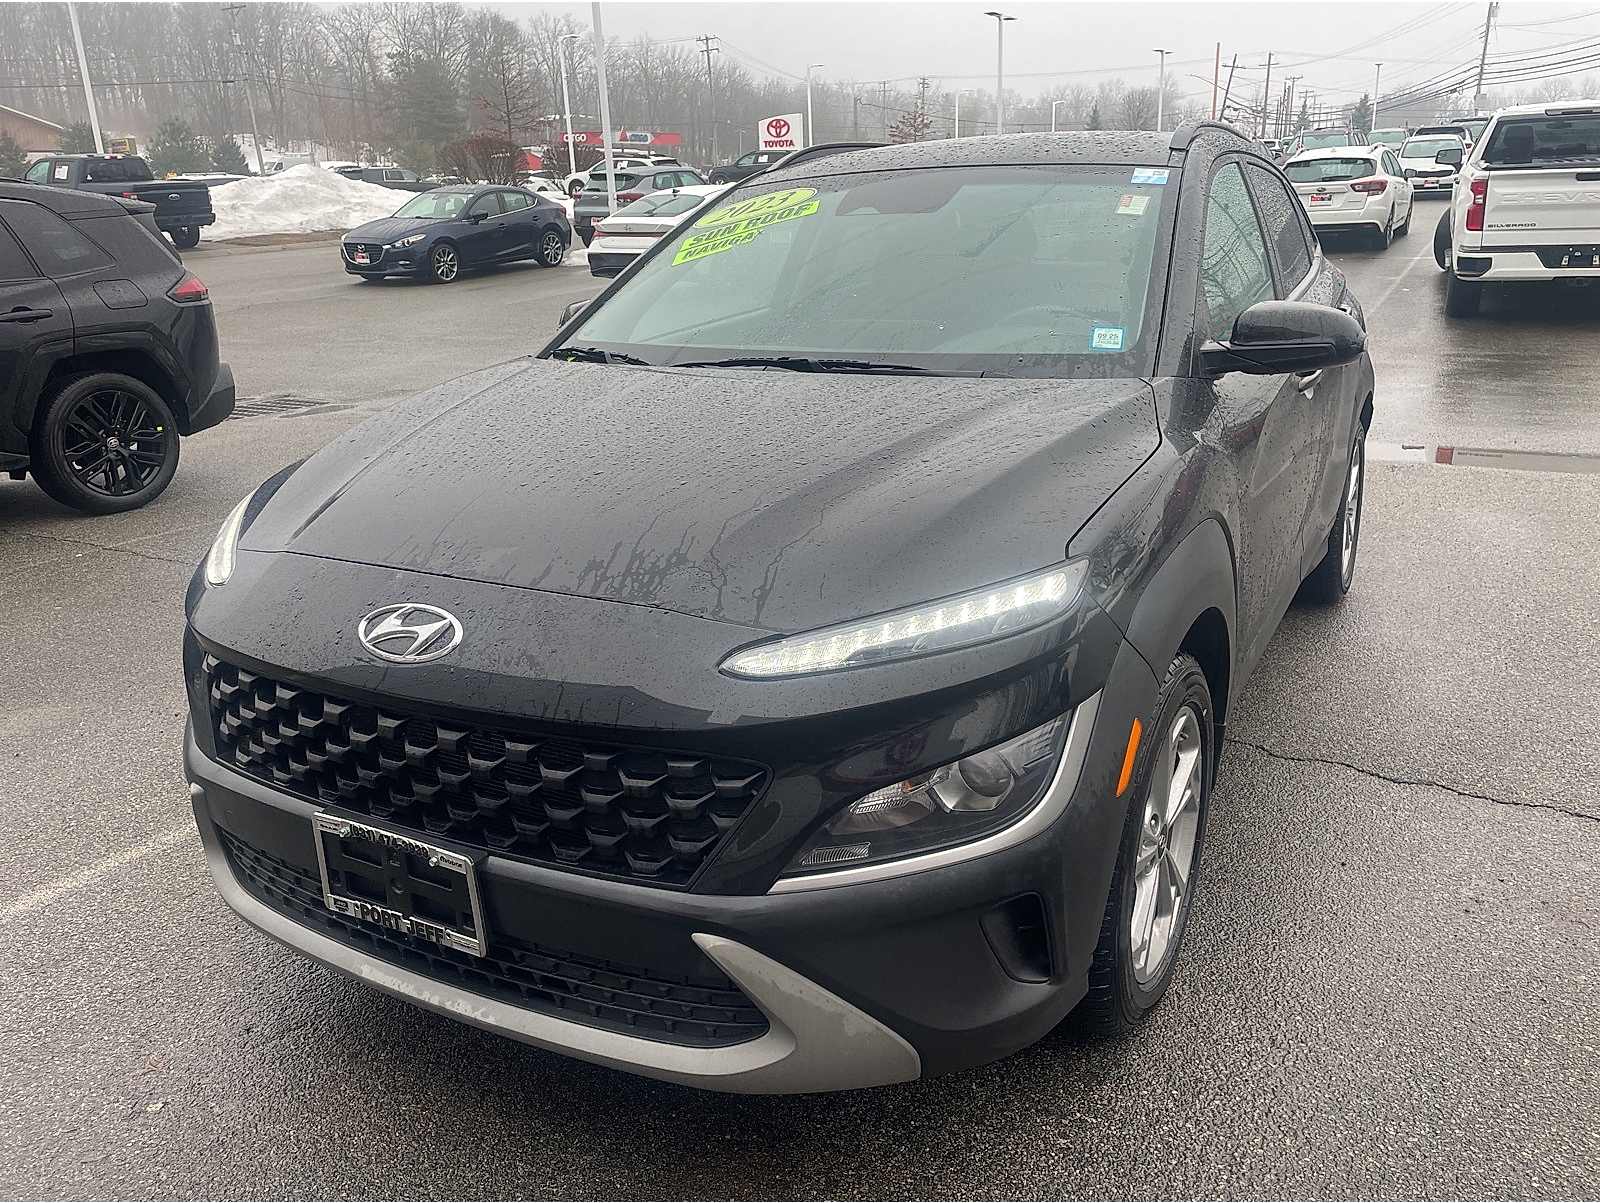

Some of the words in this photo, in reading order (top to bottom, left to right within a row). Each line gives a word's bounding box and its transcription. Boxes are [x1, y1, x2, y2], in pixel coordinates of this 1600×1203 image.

[763, 140, 795, 148] TOYOTA
[688, 223, 741, 247] SUN
[742, 202, 815, 230] ROOF
[705, 191, 797, 225] 2023
[360, 903, 401, 930] PORT
[405, 916, 444, 945] JEFF
